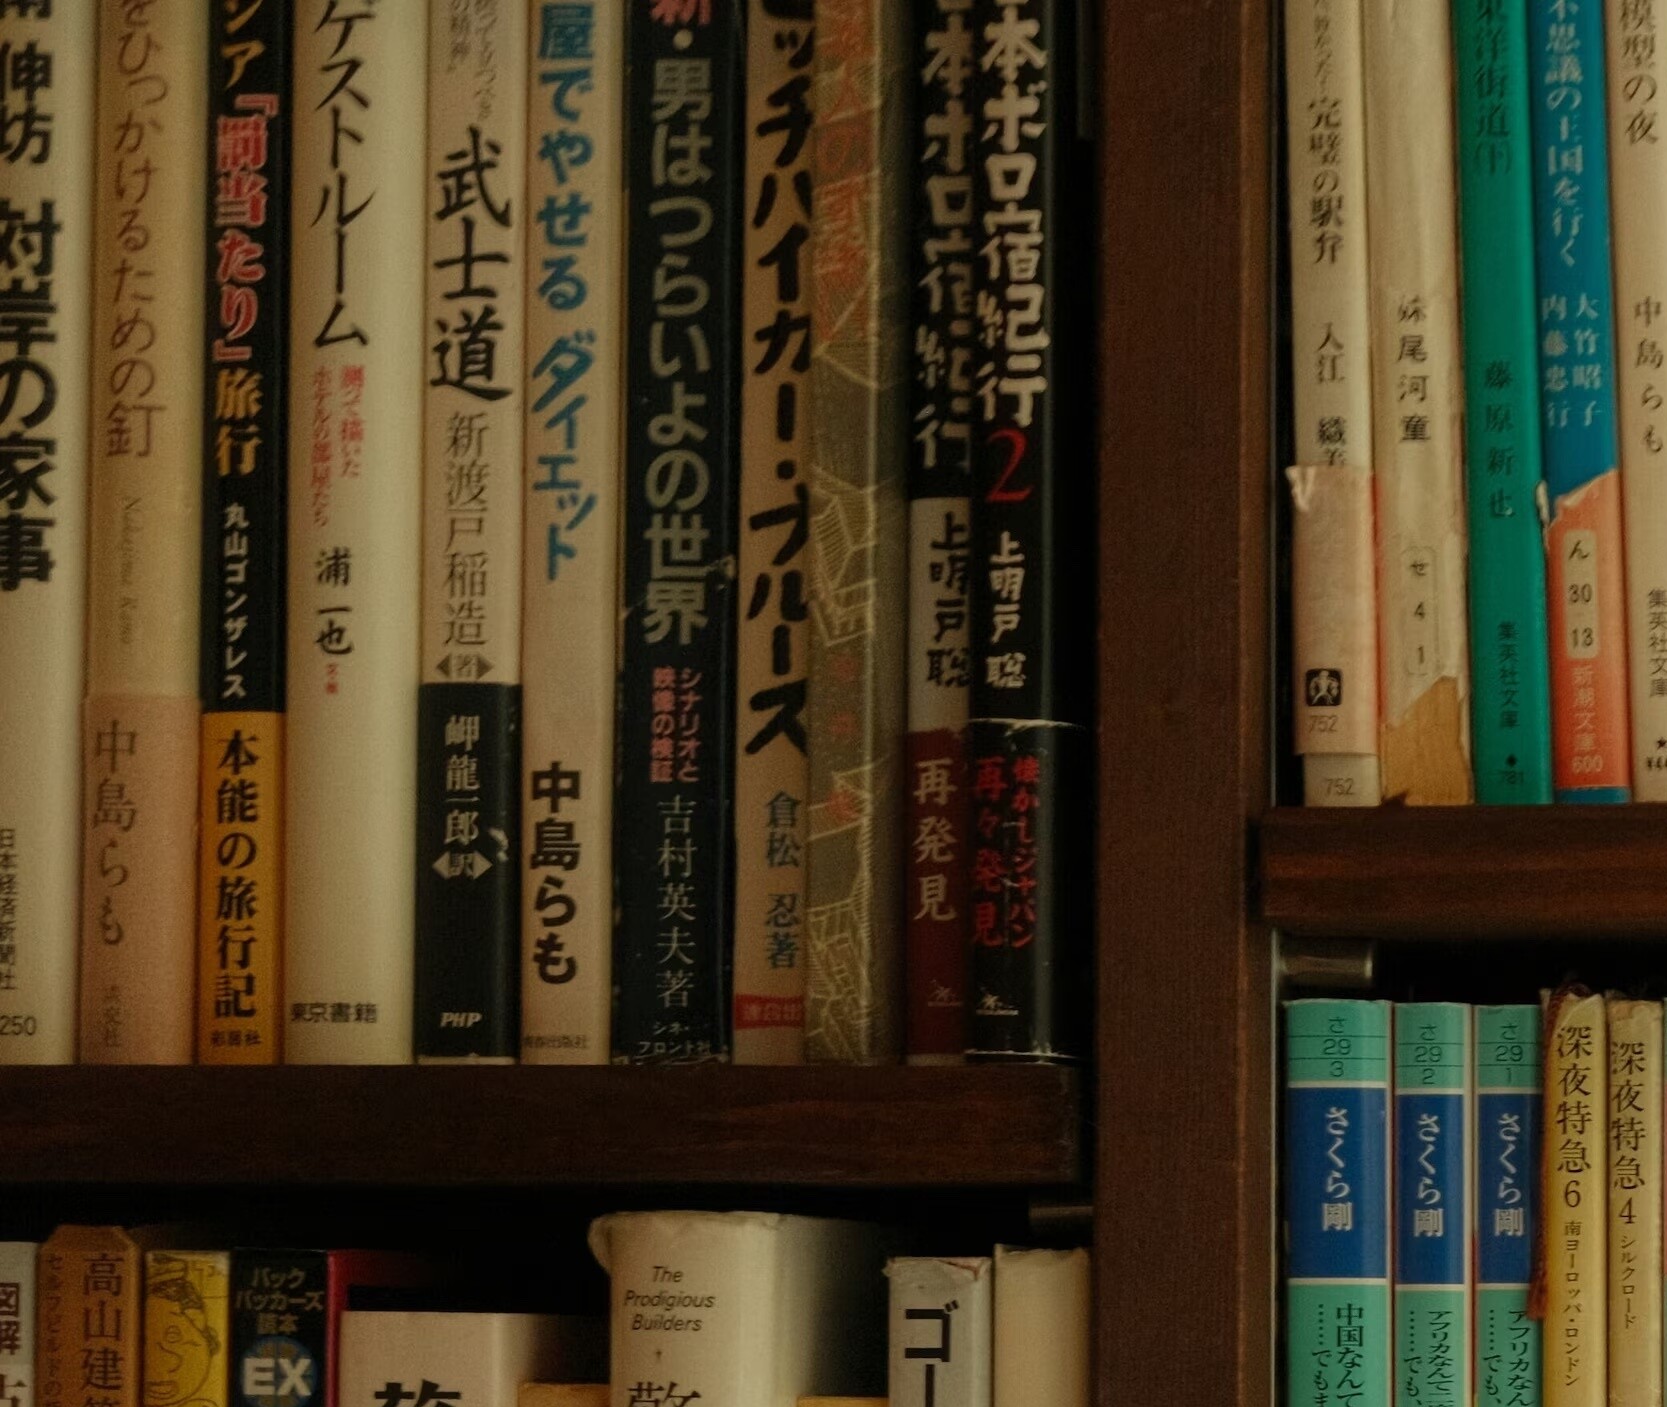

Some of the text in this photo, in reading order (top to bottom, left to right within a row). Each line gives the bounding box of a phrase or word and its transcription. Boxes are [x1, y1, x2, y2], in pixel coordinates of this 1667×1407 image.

[430, 125, 513, 402] 武士道
[1397, 293, 1432, 443] 妹尾河童
[222, 502, 250, 700] 丸山ゴンザレス
[314, 545, 353, 656] 浦一也
[442, 408, 492, 648] 新渡戸稲造
[92, 718, 138, 945] 中島らも
[214, 728, 261, 1020] 本能の旅行記
[531, 760, 583, 987] 中島らも
[655, 795, 699, 1010] 吉村英夫著
[912, 755, 960, 922] 再発見
[291, 1002, 378, 1026] 東京書籍
[439, 1011, 483, 1029] PHP
[1319, 1103, 1356, 1236] さくら剛
[1556, 1026, 1594, 1210] 深夜特急6
[624, 1265, 716, 1311] The Prodigious
[630, 1312, 703, 1333] Builders
[1562, 1219, 1582, 1388] 南ヨーロッパ・ロンドン
[242, 1355, 314, 1399] EX
